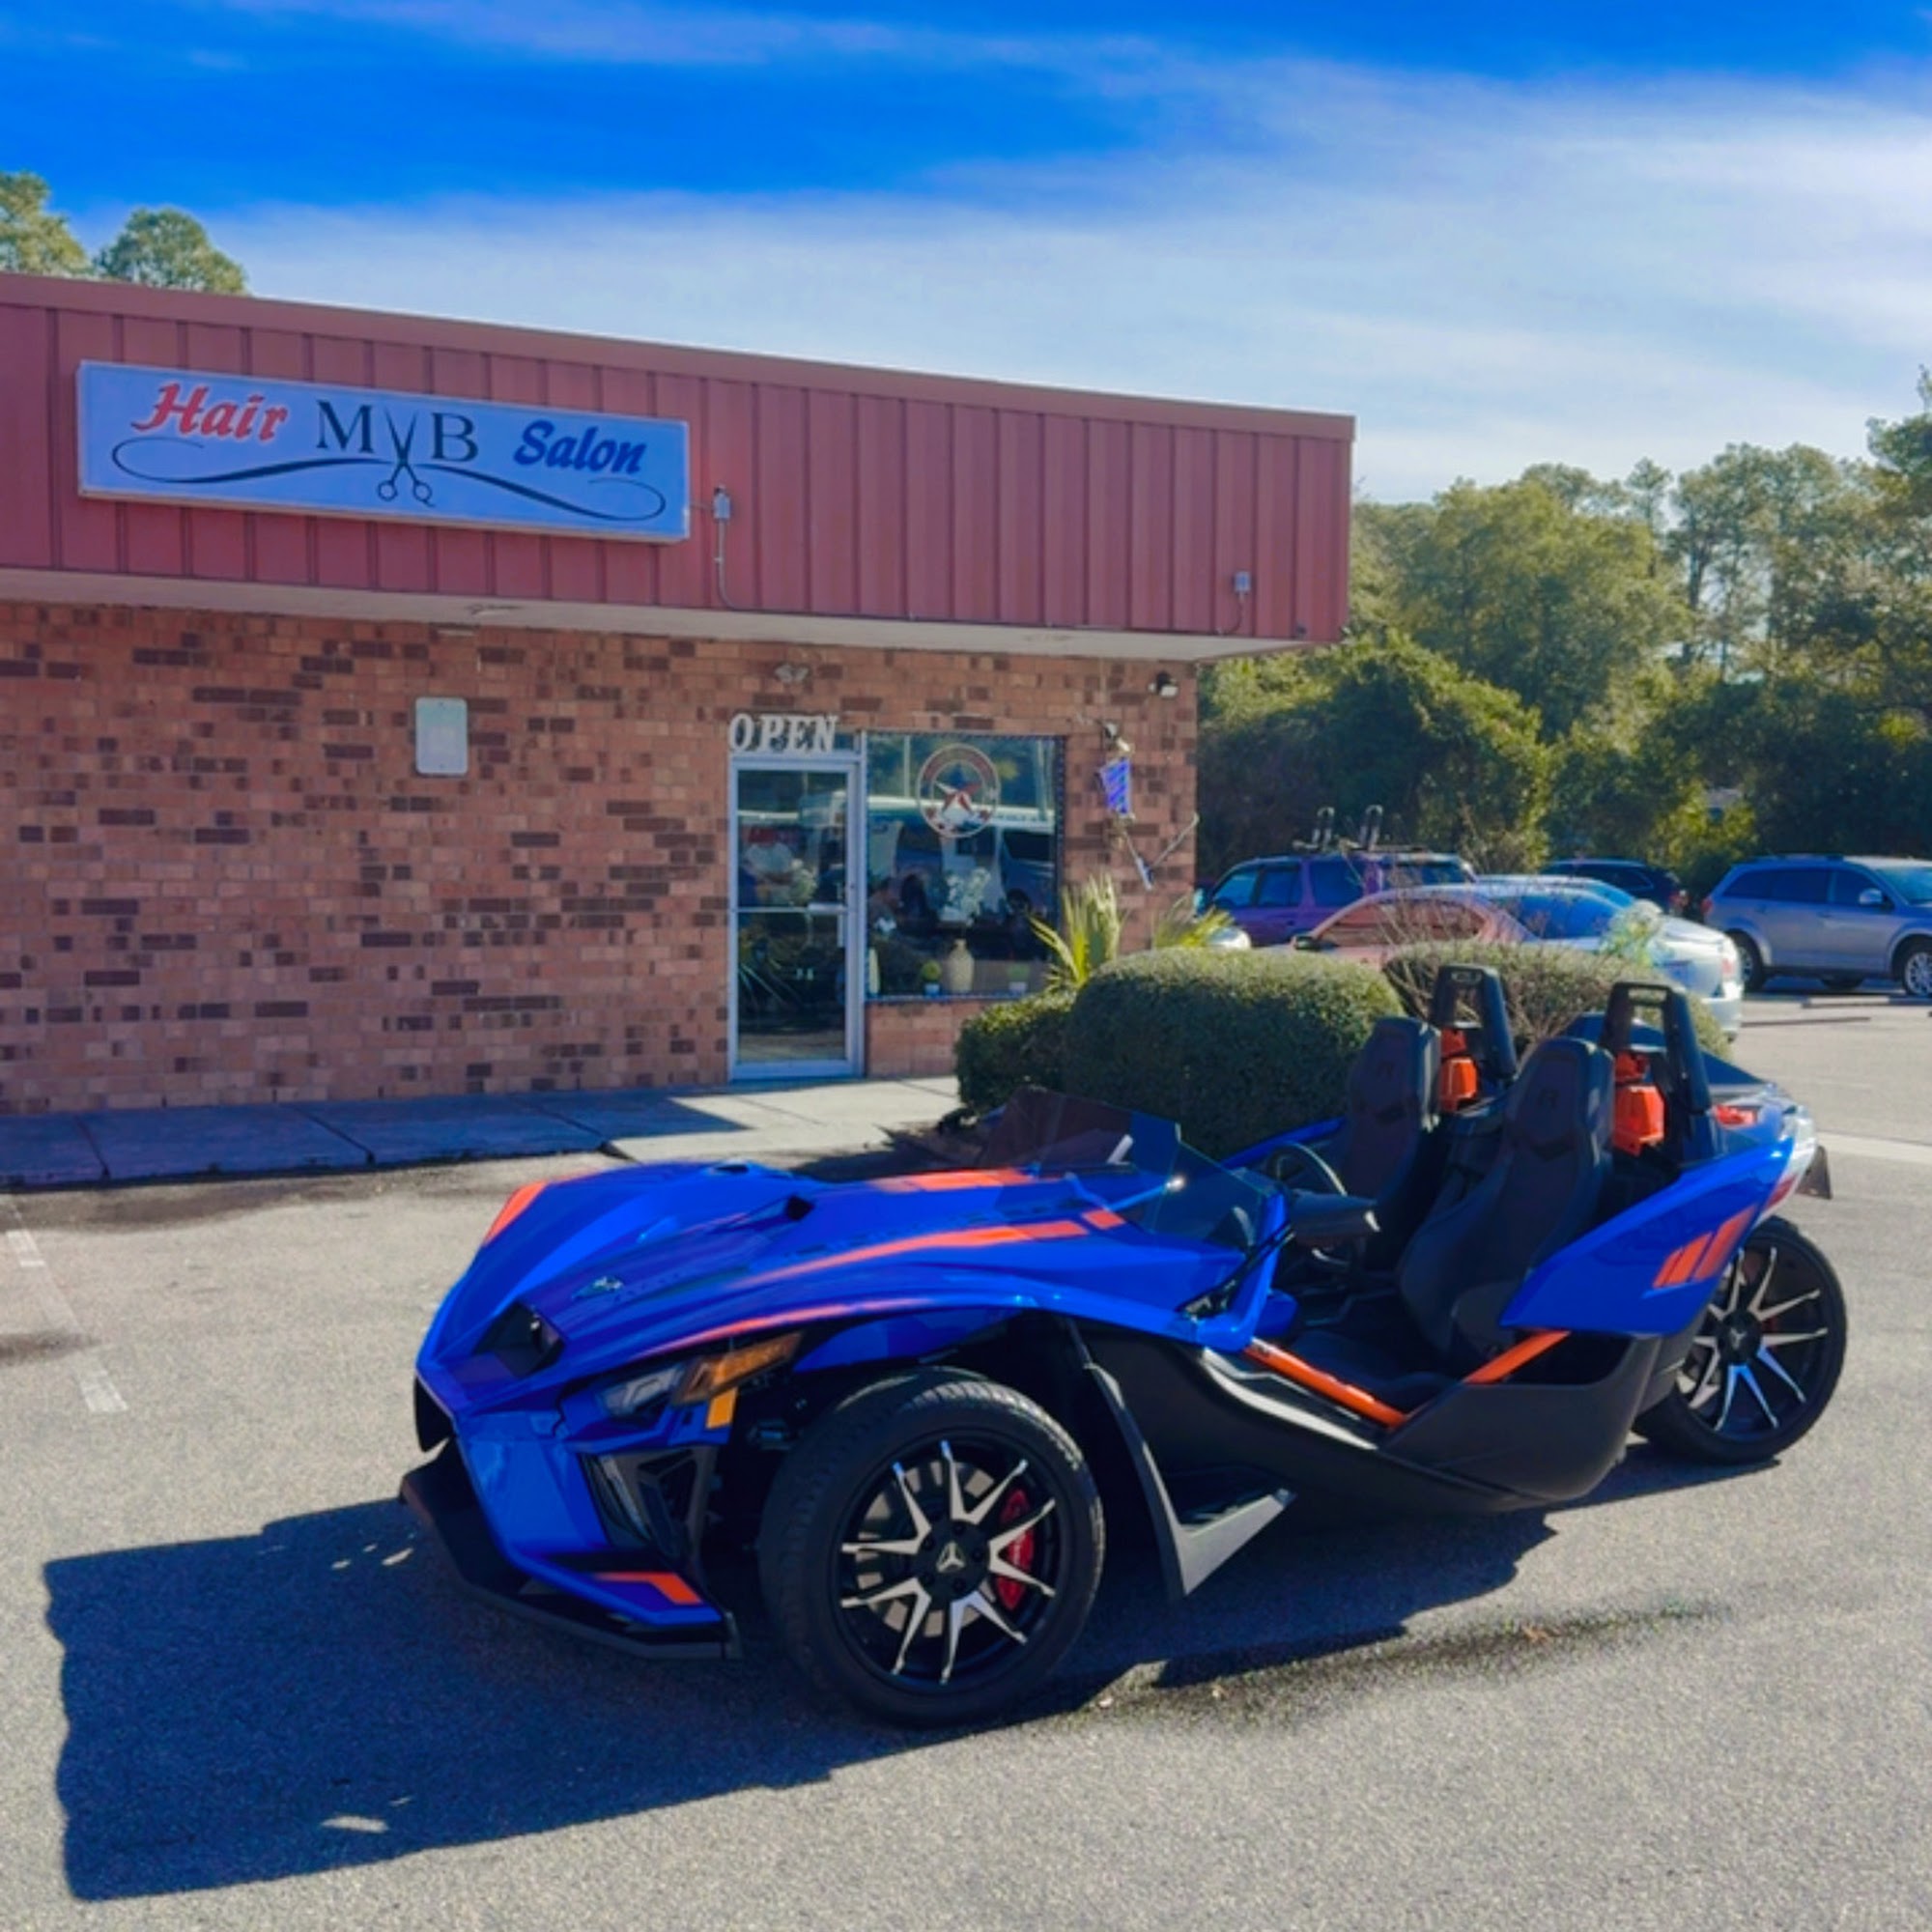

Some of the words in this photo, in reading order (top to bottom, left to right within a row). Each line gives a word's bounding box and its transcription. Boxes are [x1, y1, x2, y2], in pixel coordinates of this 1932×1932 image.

[129, 383, 288, 441] Hair
[513, 420, 647, 474] Salon
[728, 712, 838, 753] OPEN
